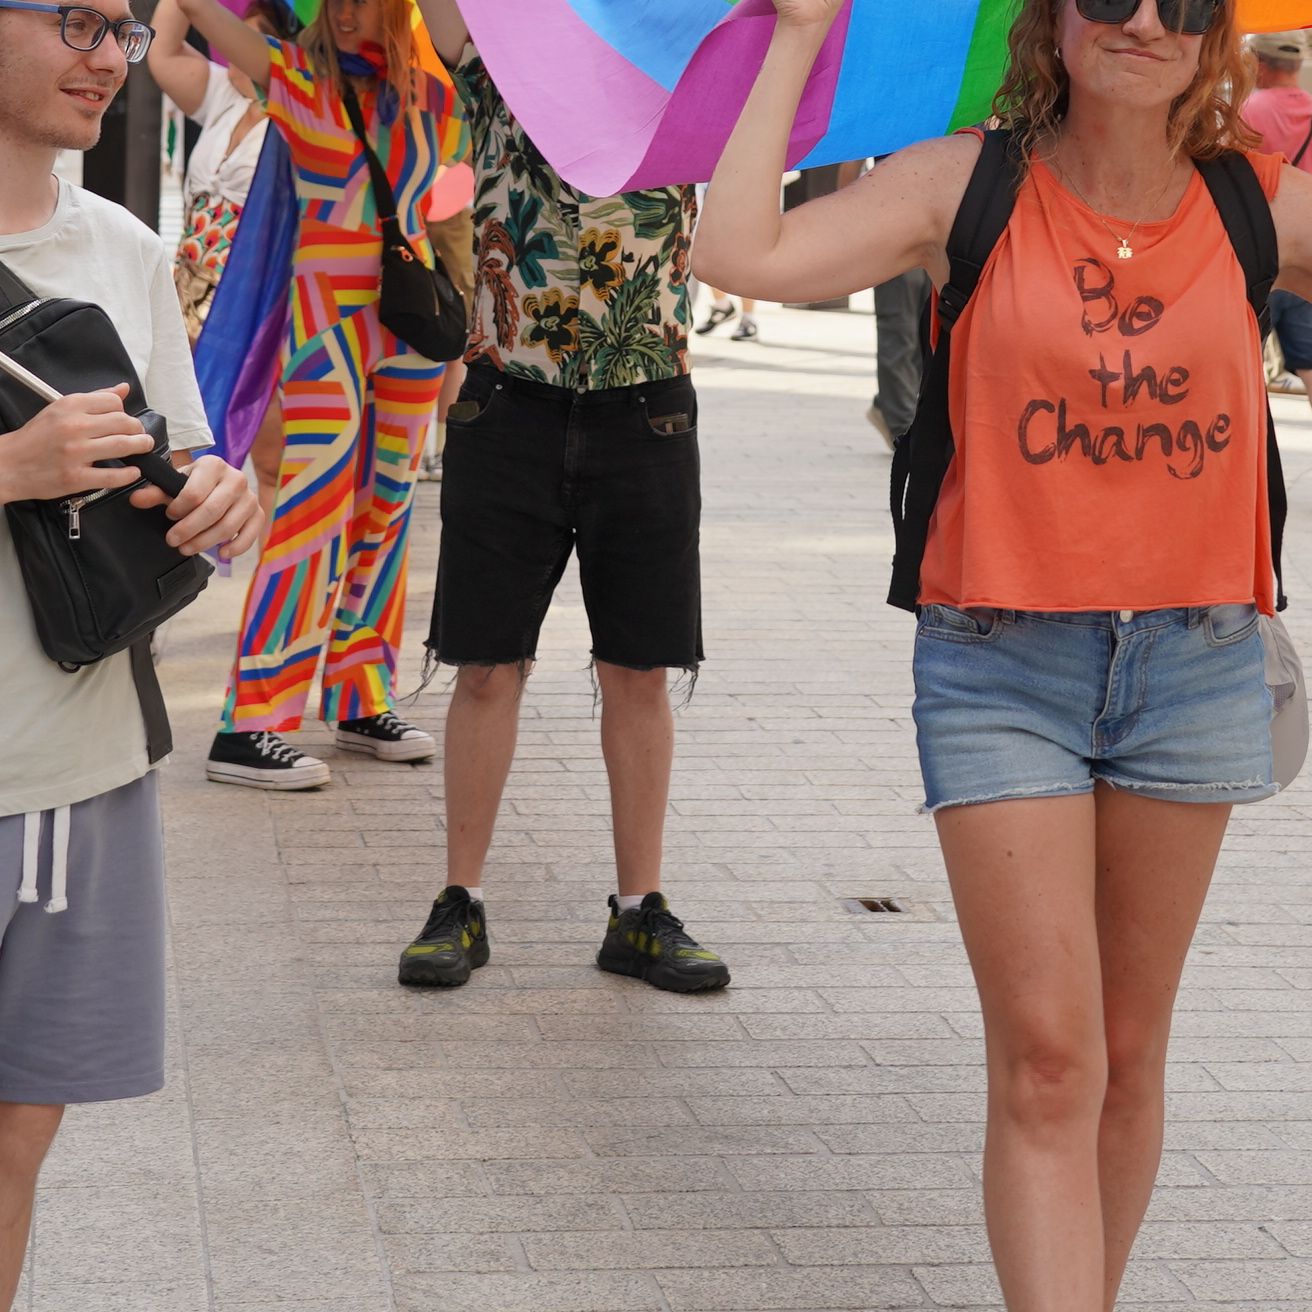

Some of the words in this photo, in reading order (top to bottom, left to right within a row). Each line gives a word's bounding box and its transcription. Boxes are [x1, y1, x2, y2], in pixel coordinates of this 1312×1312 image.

[1074, 257, 1164, 337] Be
[1089, 349, 1190, 409] the
[1017, 397, 1232, 480] Change
